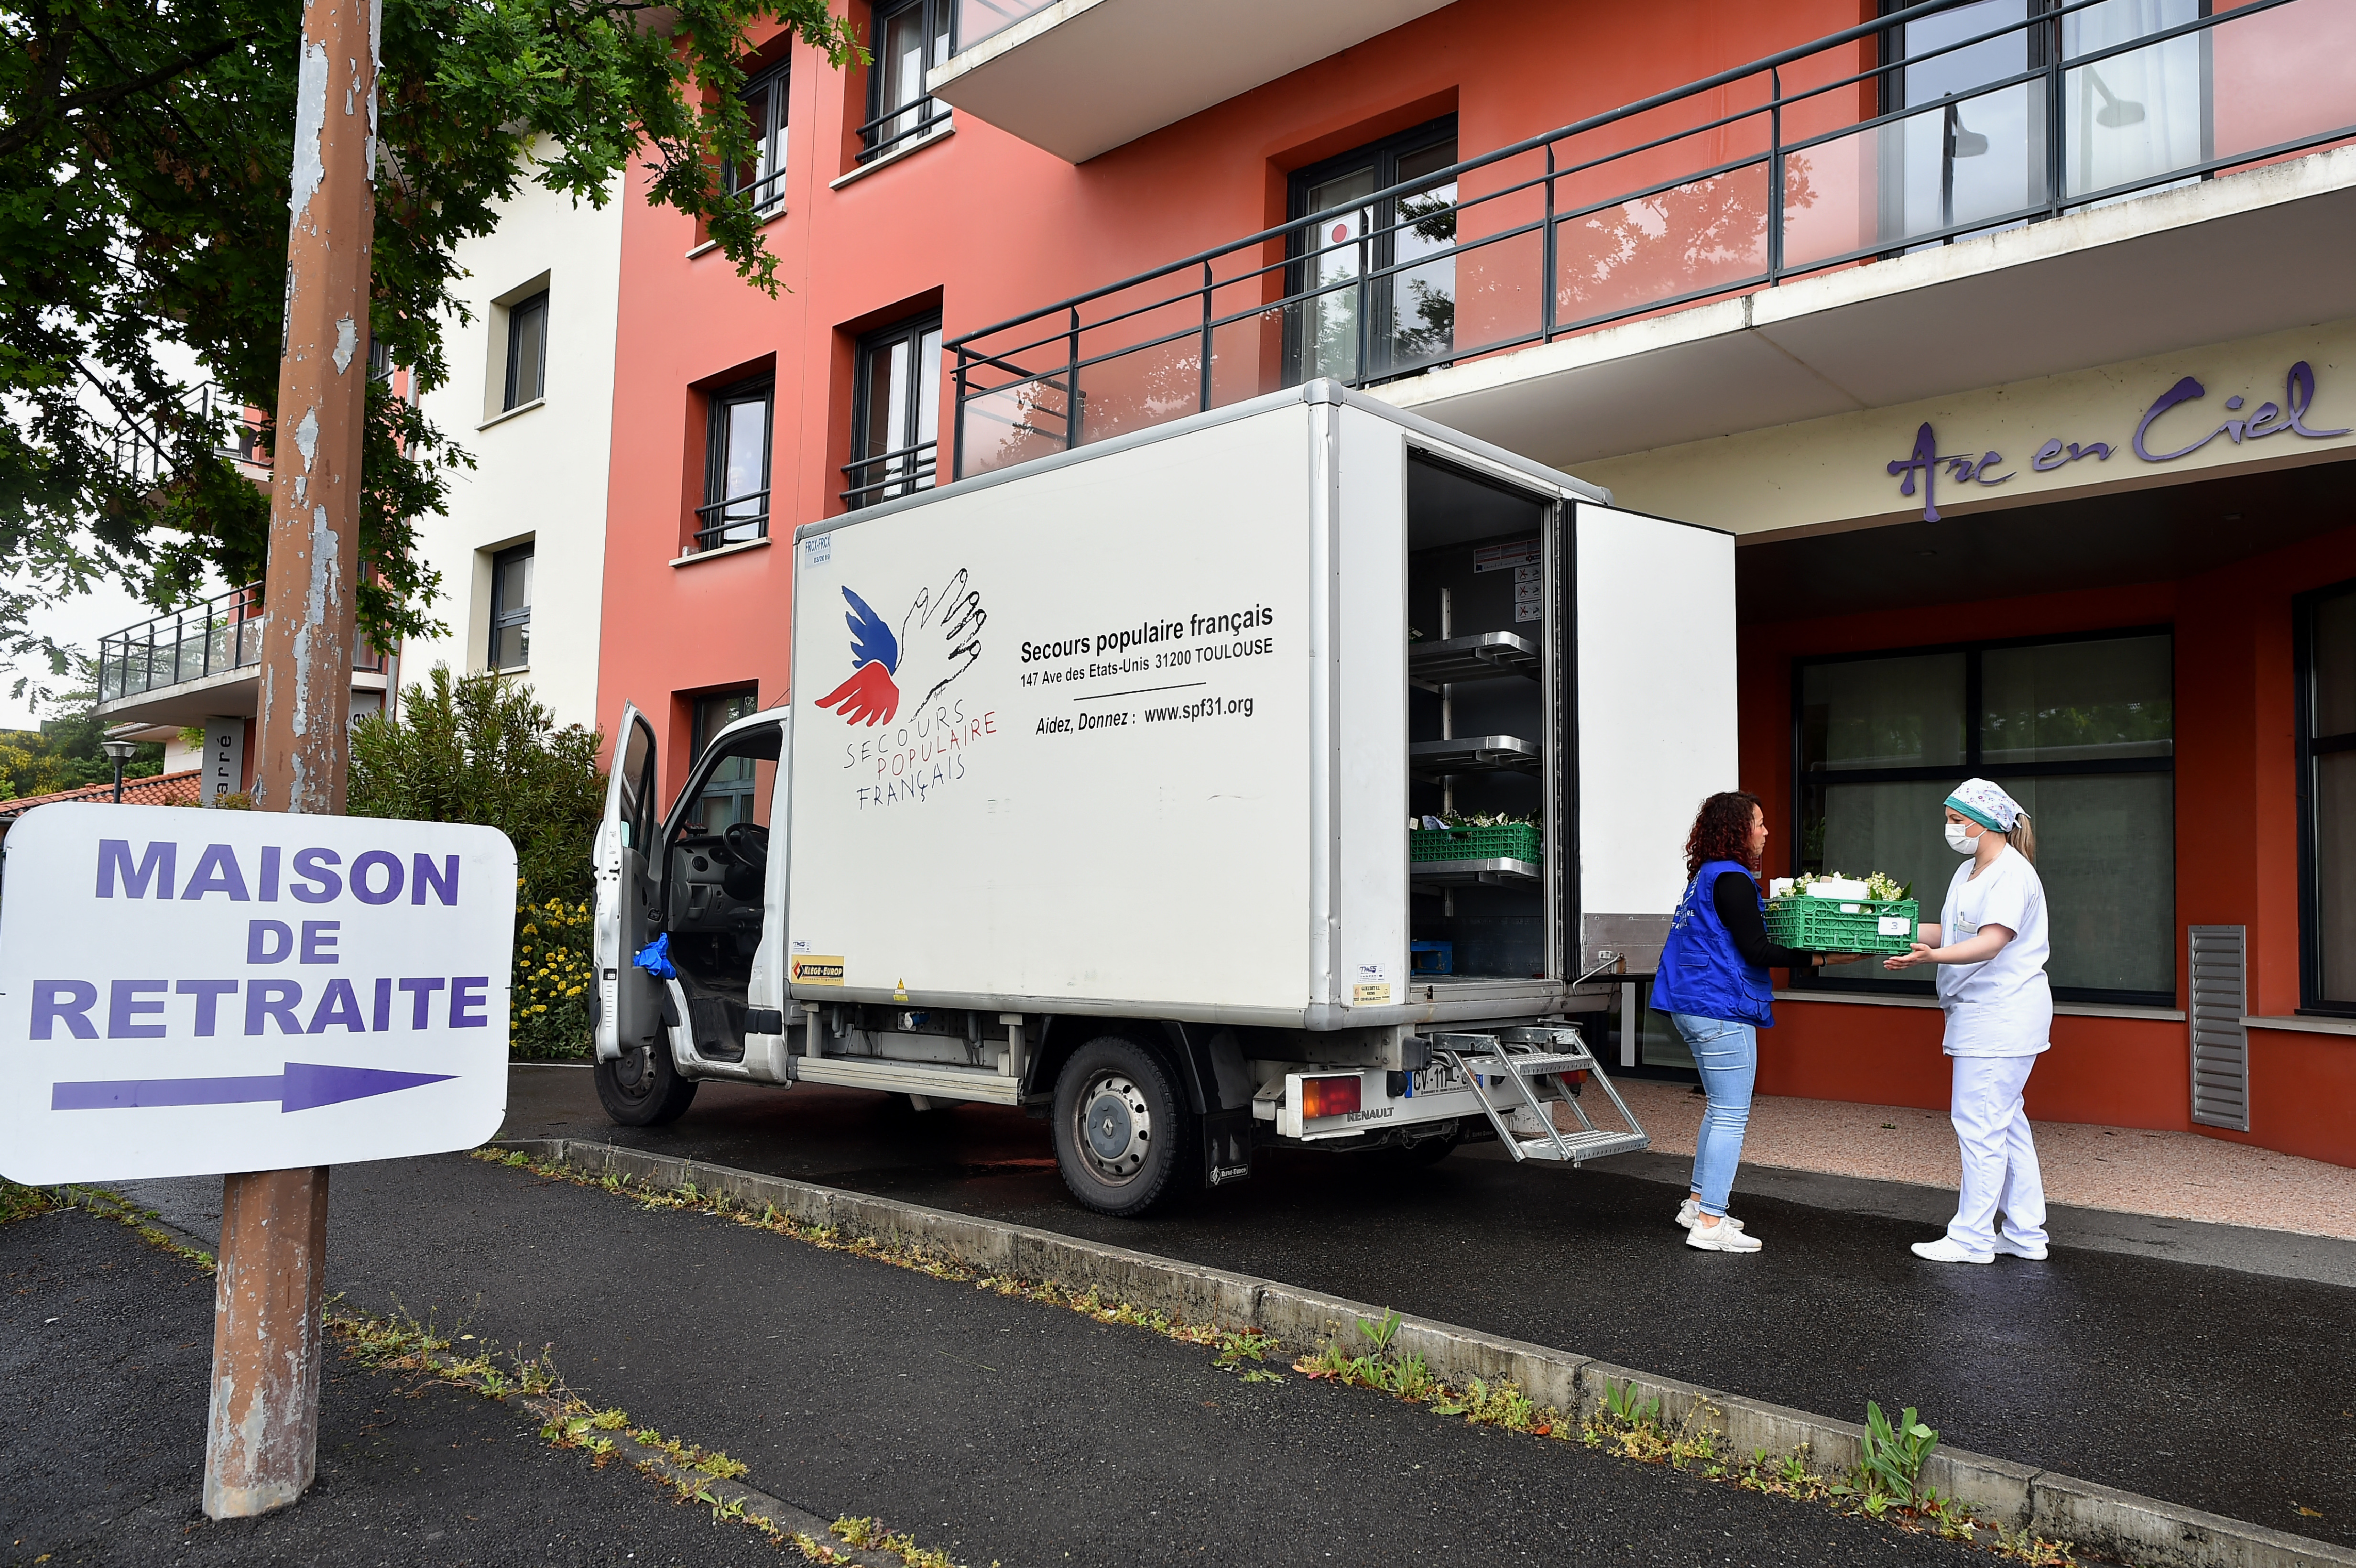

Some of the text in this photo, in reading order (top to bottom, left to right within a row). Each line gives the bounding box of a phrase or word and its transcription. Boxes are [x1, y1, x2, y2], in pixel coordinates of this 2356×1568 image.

[1887, 360, 2355, 522] Arc en Ciel
[1020, 637, 1273, 687] 147 Ave des Etats-Unis 31200 TOULOUSE
[1021, 603, 1273, 663] Secours populaire français
[843, 699, 964, 769] SECOURS
[1035, 716, 1074, 735] Aidez,
[1145, 697, 1254, 723] www.spf31.org
[877, 711, 997, 781] POPULAIRE
[856, 753, 965, 811] FRANÇAIS
[95, 838, 460, 906] MAISON
[246, 919, 341, 964] DE
[1891, 922, 1898, 930] 3
[29, 976, 489, 1040] RETRAITE
[1347, 1107, 1395, 1122] RENAULT
